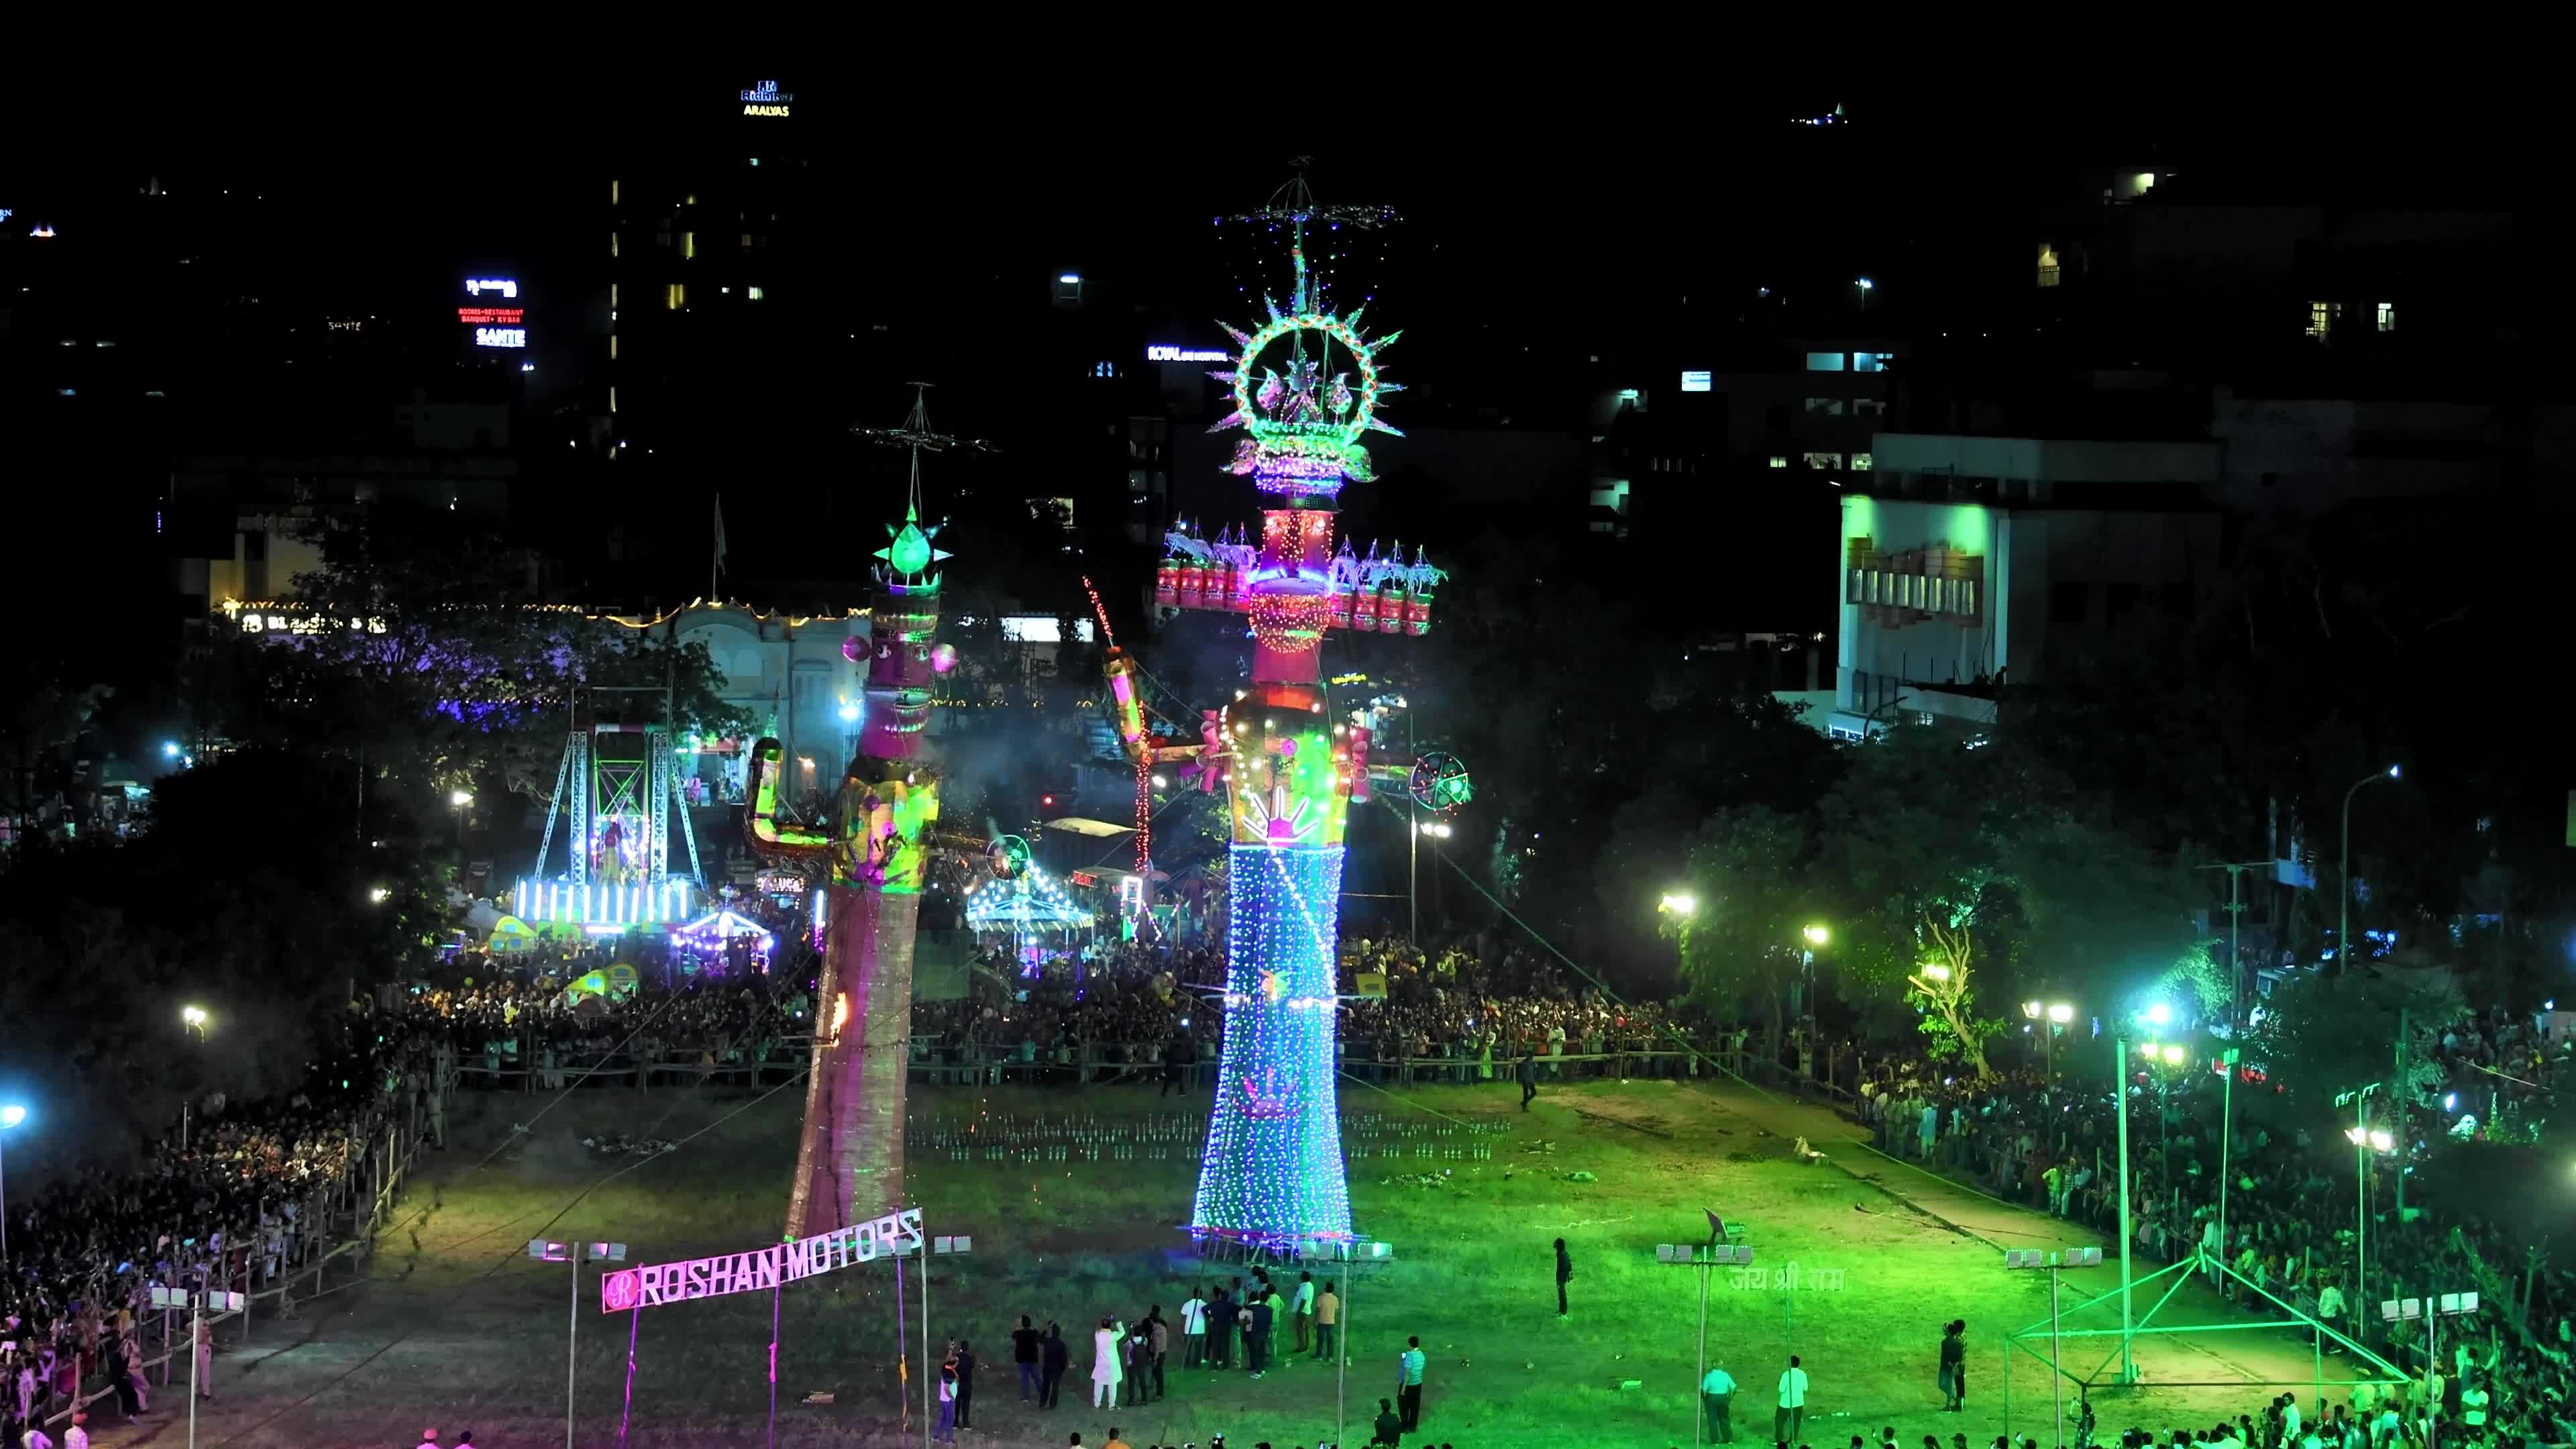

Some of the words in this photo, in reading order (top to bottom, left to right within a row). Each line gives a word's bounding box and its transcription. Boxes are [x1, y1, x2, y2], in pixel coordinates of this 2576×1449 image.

[462, 315, 490, 323] BANQUET
[476, 328, 525, 344] SANTE
[1148, 346, 1180, 361] ROYAL
[639, 1248, 780, 1306] ROSHAN
[786, 1209, 923, 1281] MOTORS
[1729, 1267, 1768, 1291] जय
[1775, 1260, 1799, 1291] श्री
[1809, 1267, 1847, 1292] राम
